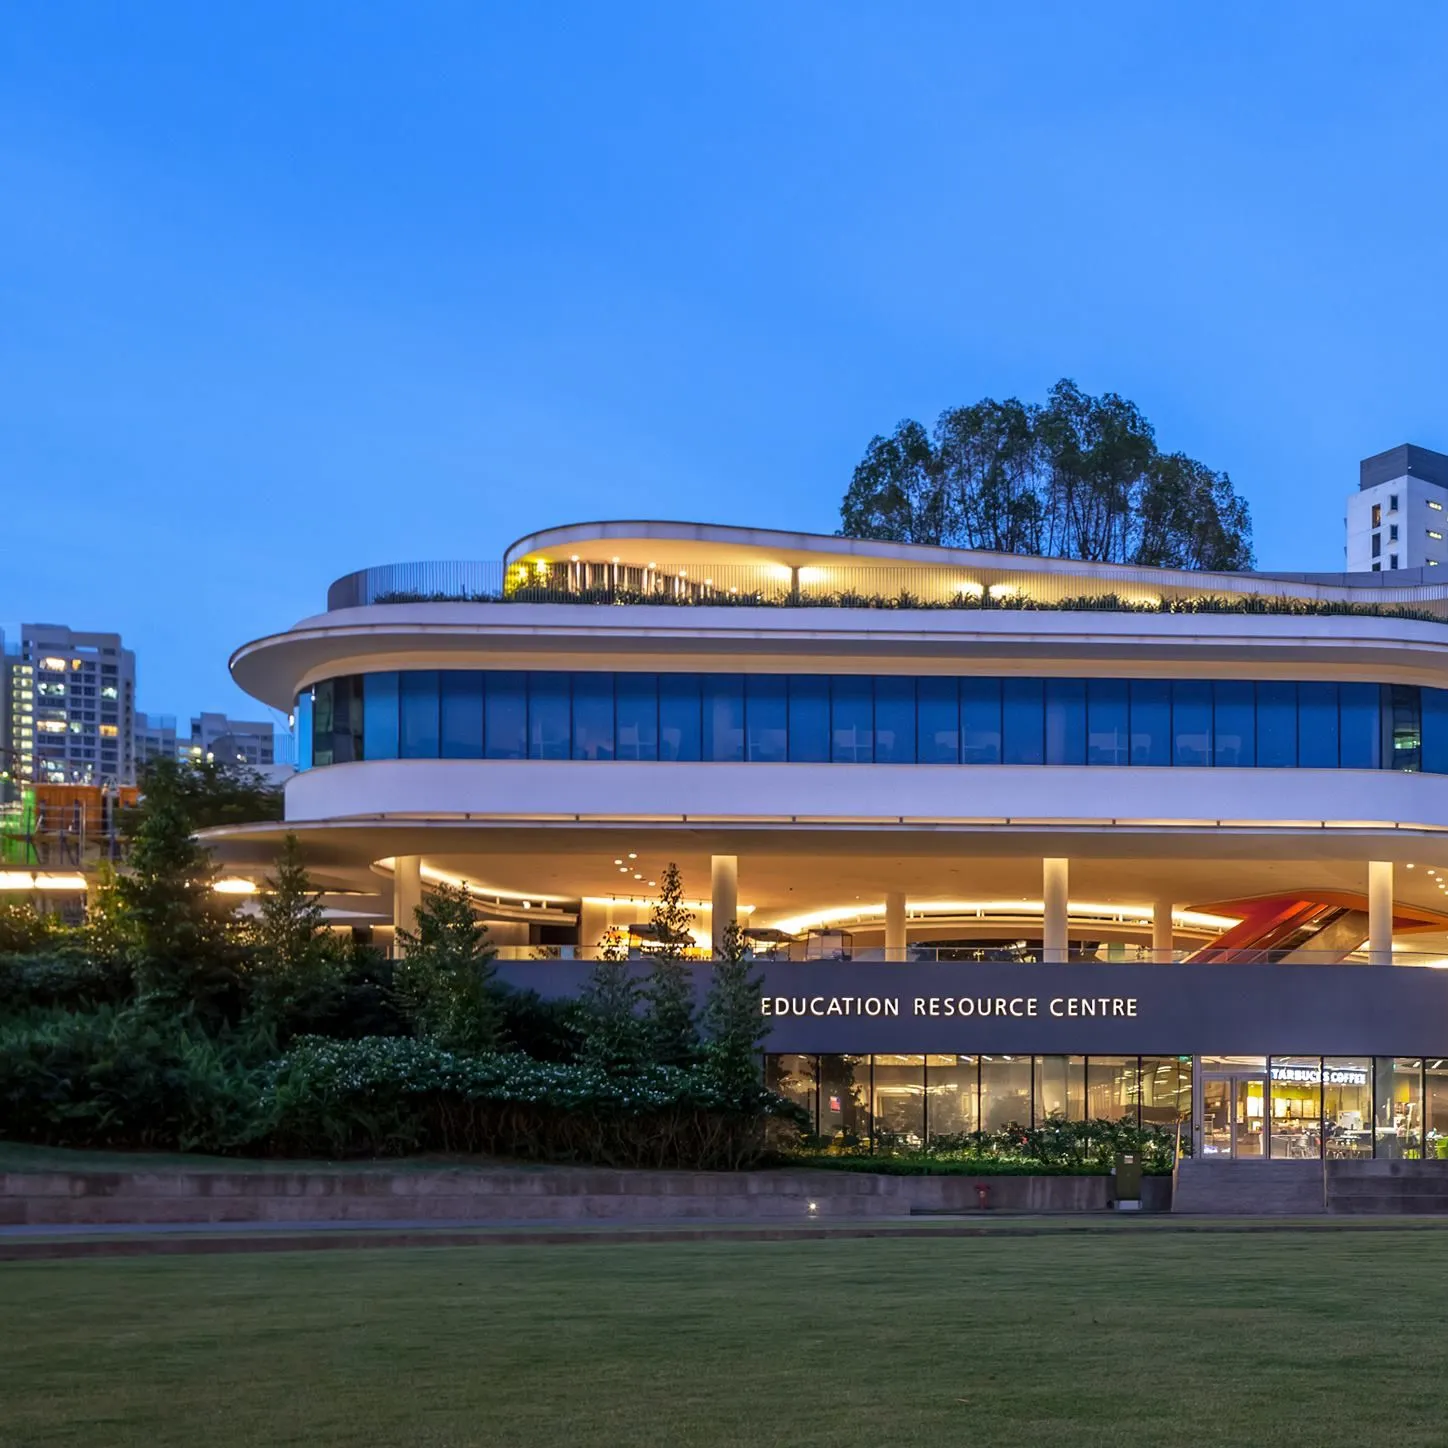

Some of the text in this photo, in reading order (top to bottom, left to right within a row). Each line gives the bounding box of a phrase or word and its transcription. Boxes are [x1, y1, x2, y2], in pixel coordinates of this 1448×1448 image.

[761, 997, 1138, 1017] EDUCATION RESOURCE CENTRE
[1270, 1069, 1366, 1084] TARBUCS COFFEE
